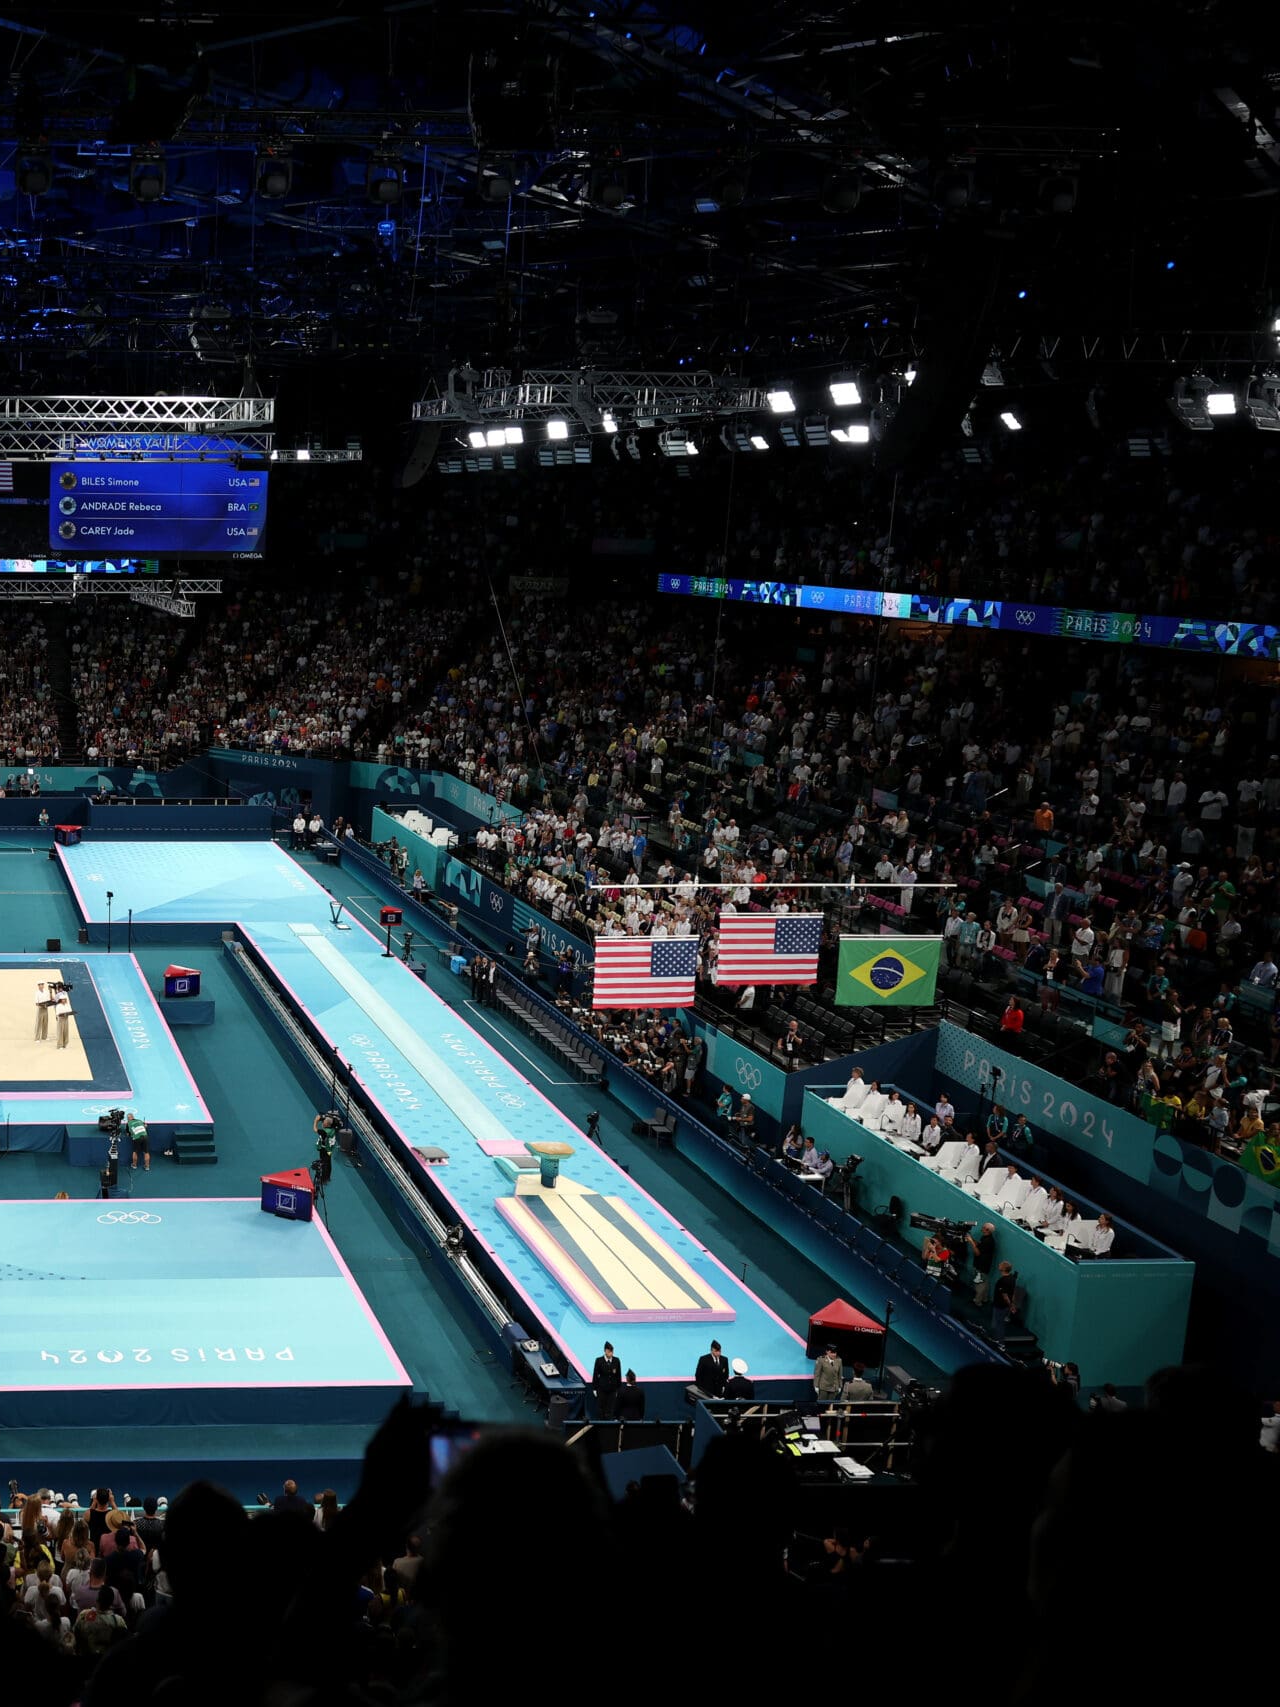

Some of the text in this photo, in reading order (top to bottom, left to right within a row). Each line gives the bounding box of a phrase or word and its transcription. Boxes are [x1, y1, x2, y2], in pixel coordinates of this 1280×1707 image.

[143, 437, 179, 449] VAULT
[81, 477, 247, 488] BILES Simone USA
[80, 502, 247, 512] ANDRADE Rebeca BRA
[80, 527, 246, 537] CAREY Jade USA
[1111, 620, 1153, 639] 2024
[272, 758, 297, 769] 2024
[7, 773, 53, 786] 224
[440, 1033, 476, 1057] 2024
[386, 1081, 423, 1111] 2024
[1042, 1091, 1114, 1149] 2024
[40, 1348, 152, 1365] 2024
